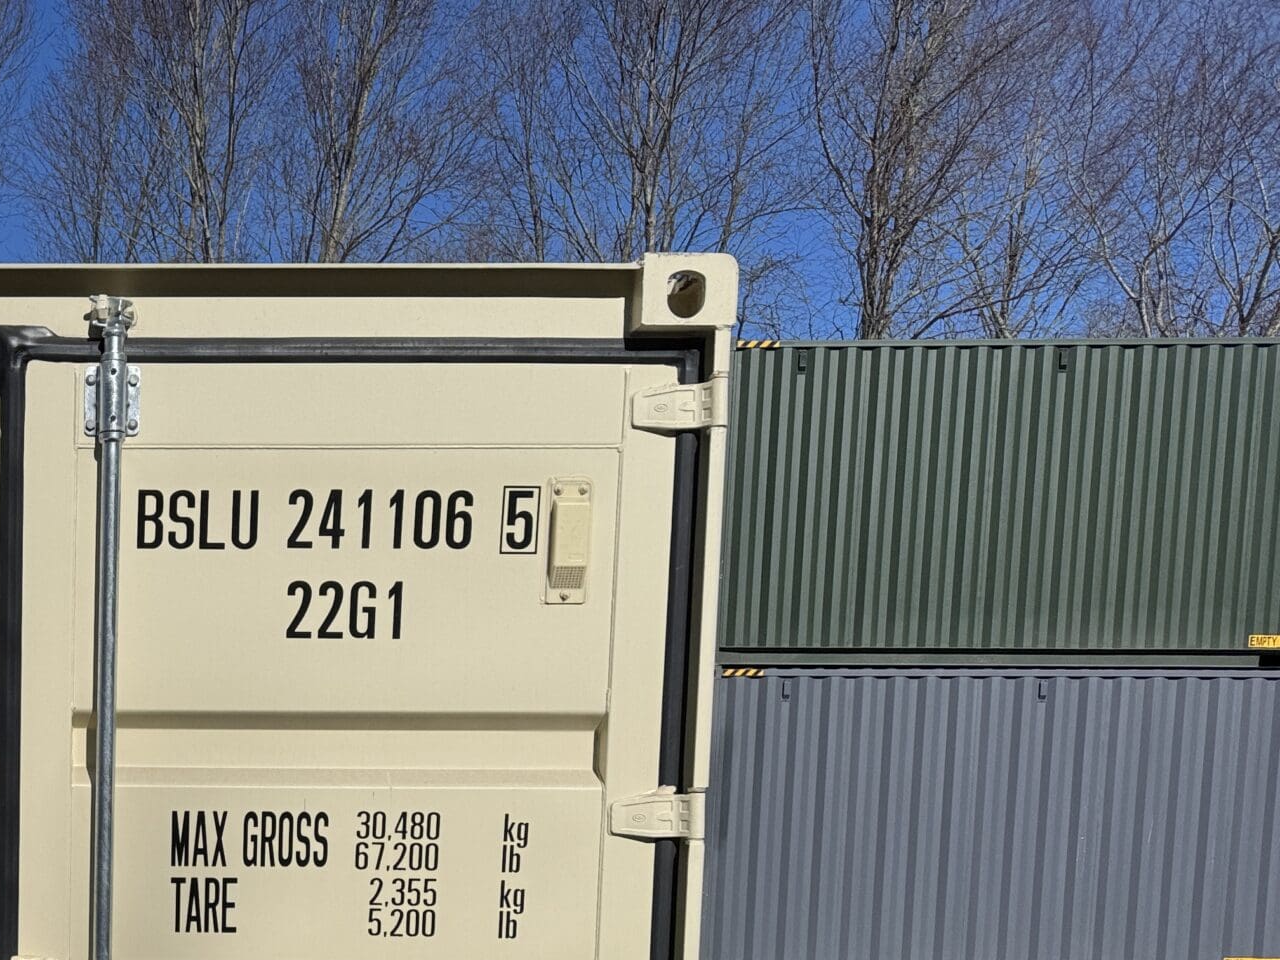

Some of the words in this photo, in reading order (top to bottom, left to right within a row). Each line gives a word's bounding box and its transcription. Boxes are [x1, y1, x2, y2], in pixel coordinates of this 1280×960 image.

[136, 488, 260, 550] BSLU
[286, 488, 475, 550] 241106
[504, 489, 536, 551] 5
[285, 580, 404, 639] 22G1
[1250, 636, 1278, 646] EMPTY
[170, 810, 228, 867] MAX
[242, 811, 330, 868] GROSS
[356, 811, 441, 842] 30,480
[503, 813, 529, 848] kg
[354, 842, 439, 872] 67,200
[501, 844, 521, 873] lb
[170, 877, 238, 933] TARE
[368, 878, 437, 908] 2,355
[499, 880, 525, 914] kg
[367, 909, 436, 938] 5,200
[497, 911, 517, 939] lb
